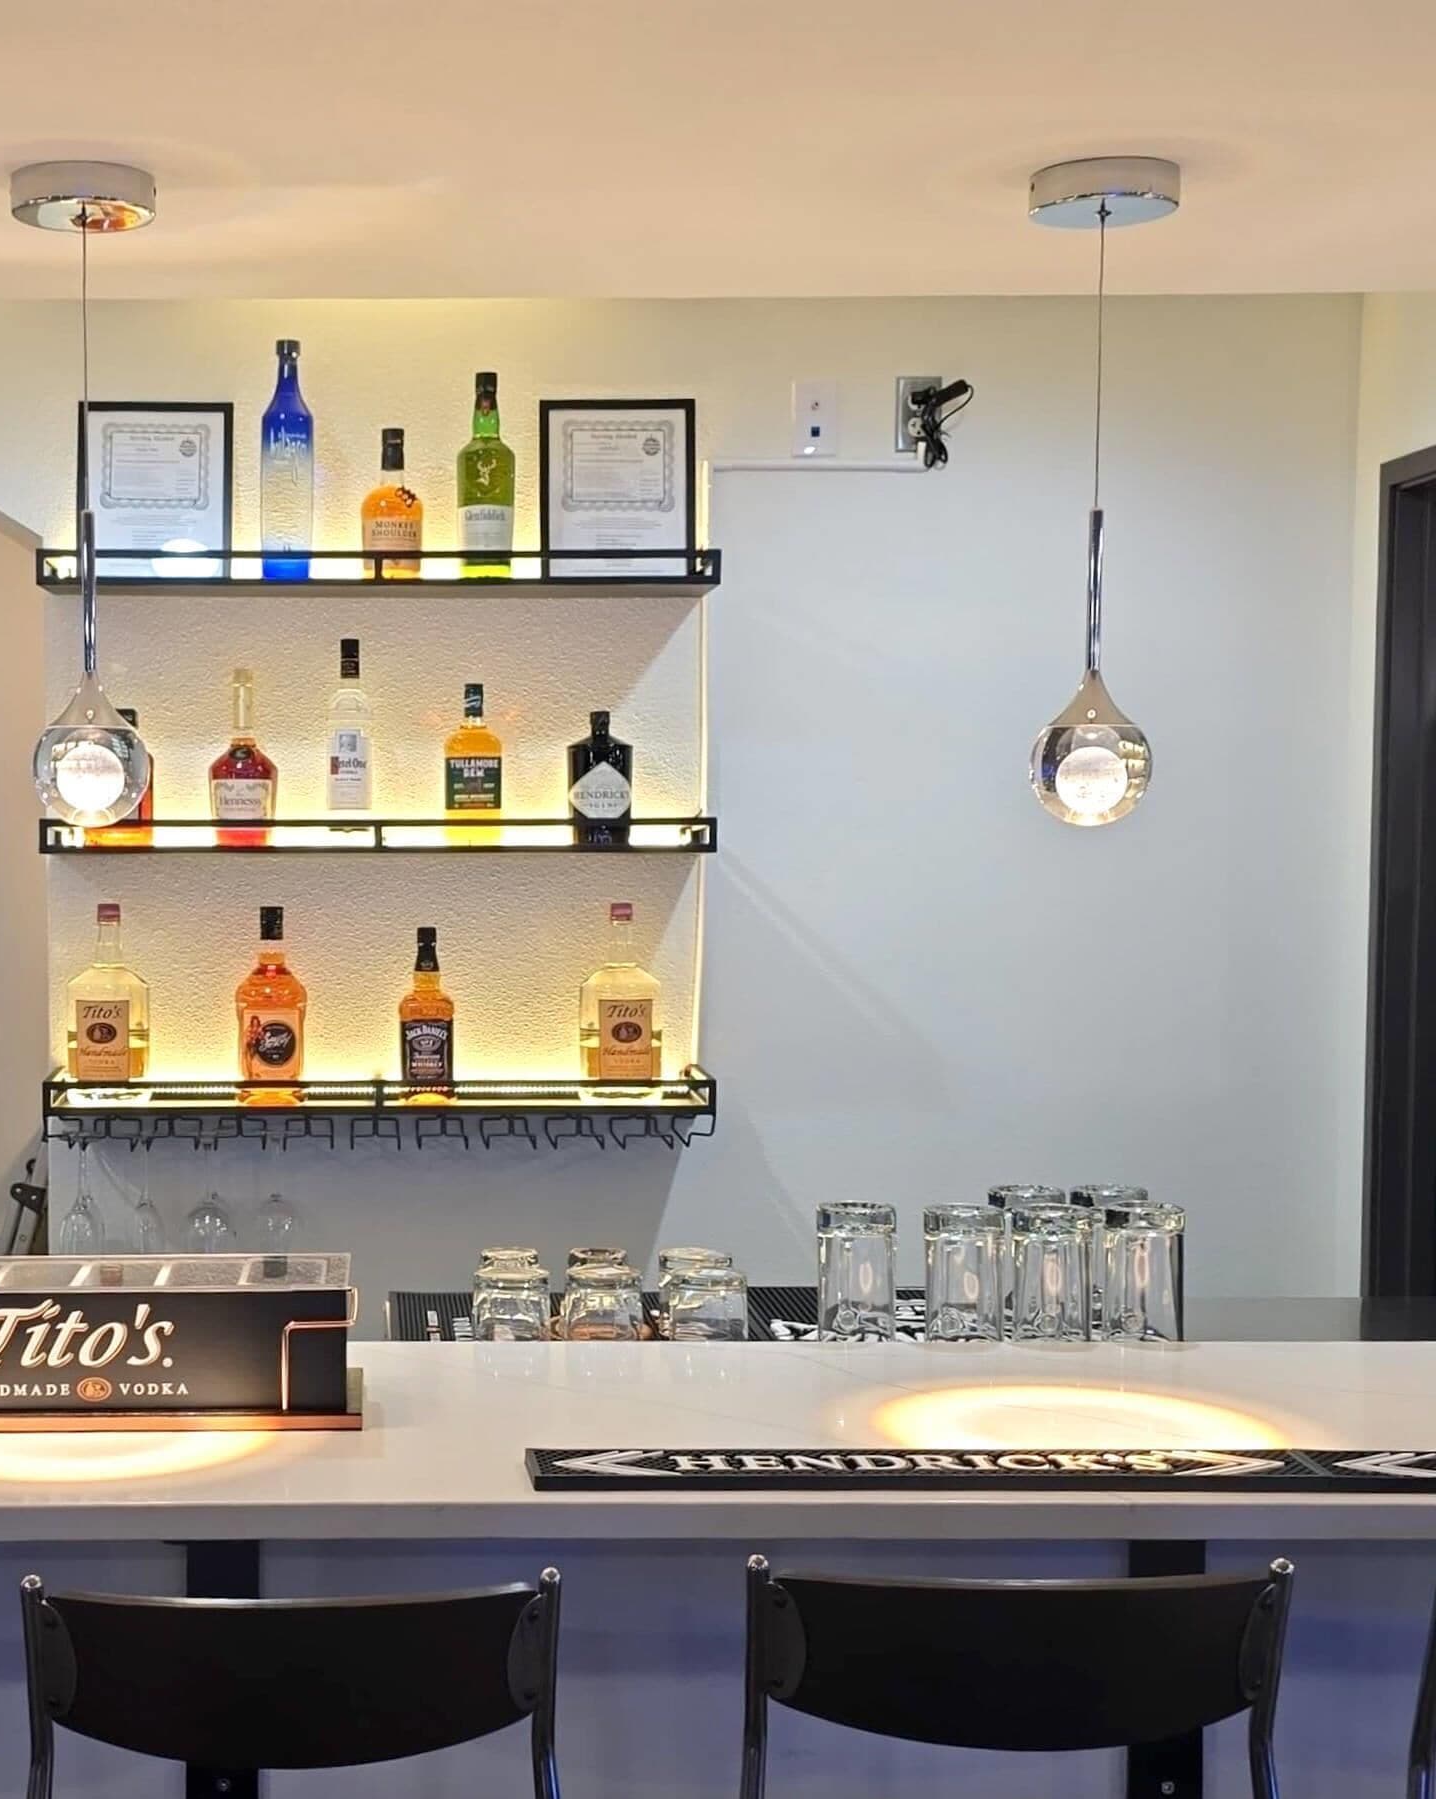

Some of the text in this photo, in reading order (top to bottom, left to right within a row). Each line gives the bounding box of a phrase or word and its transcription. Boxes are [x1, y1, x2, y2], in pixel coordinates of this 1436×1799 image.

[83, 1004, 122, 1019] Tito's
[606, 1003, 646, 1018] Tito's
[119, 1383, 189, 1396] VODKA
[668, 1452, 1174, 1472] HENDRICK'S
